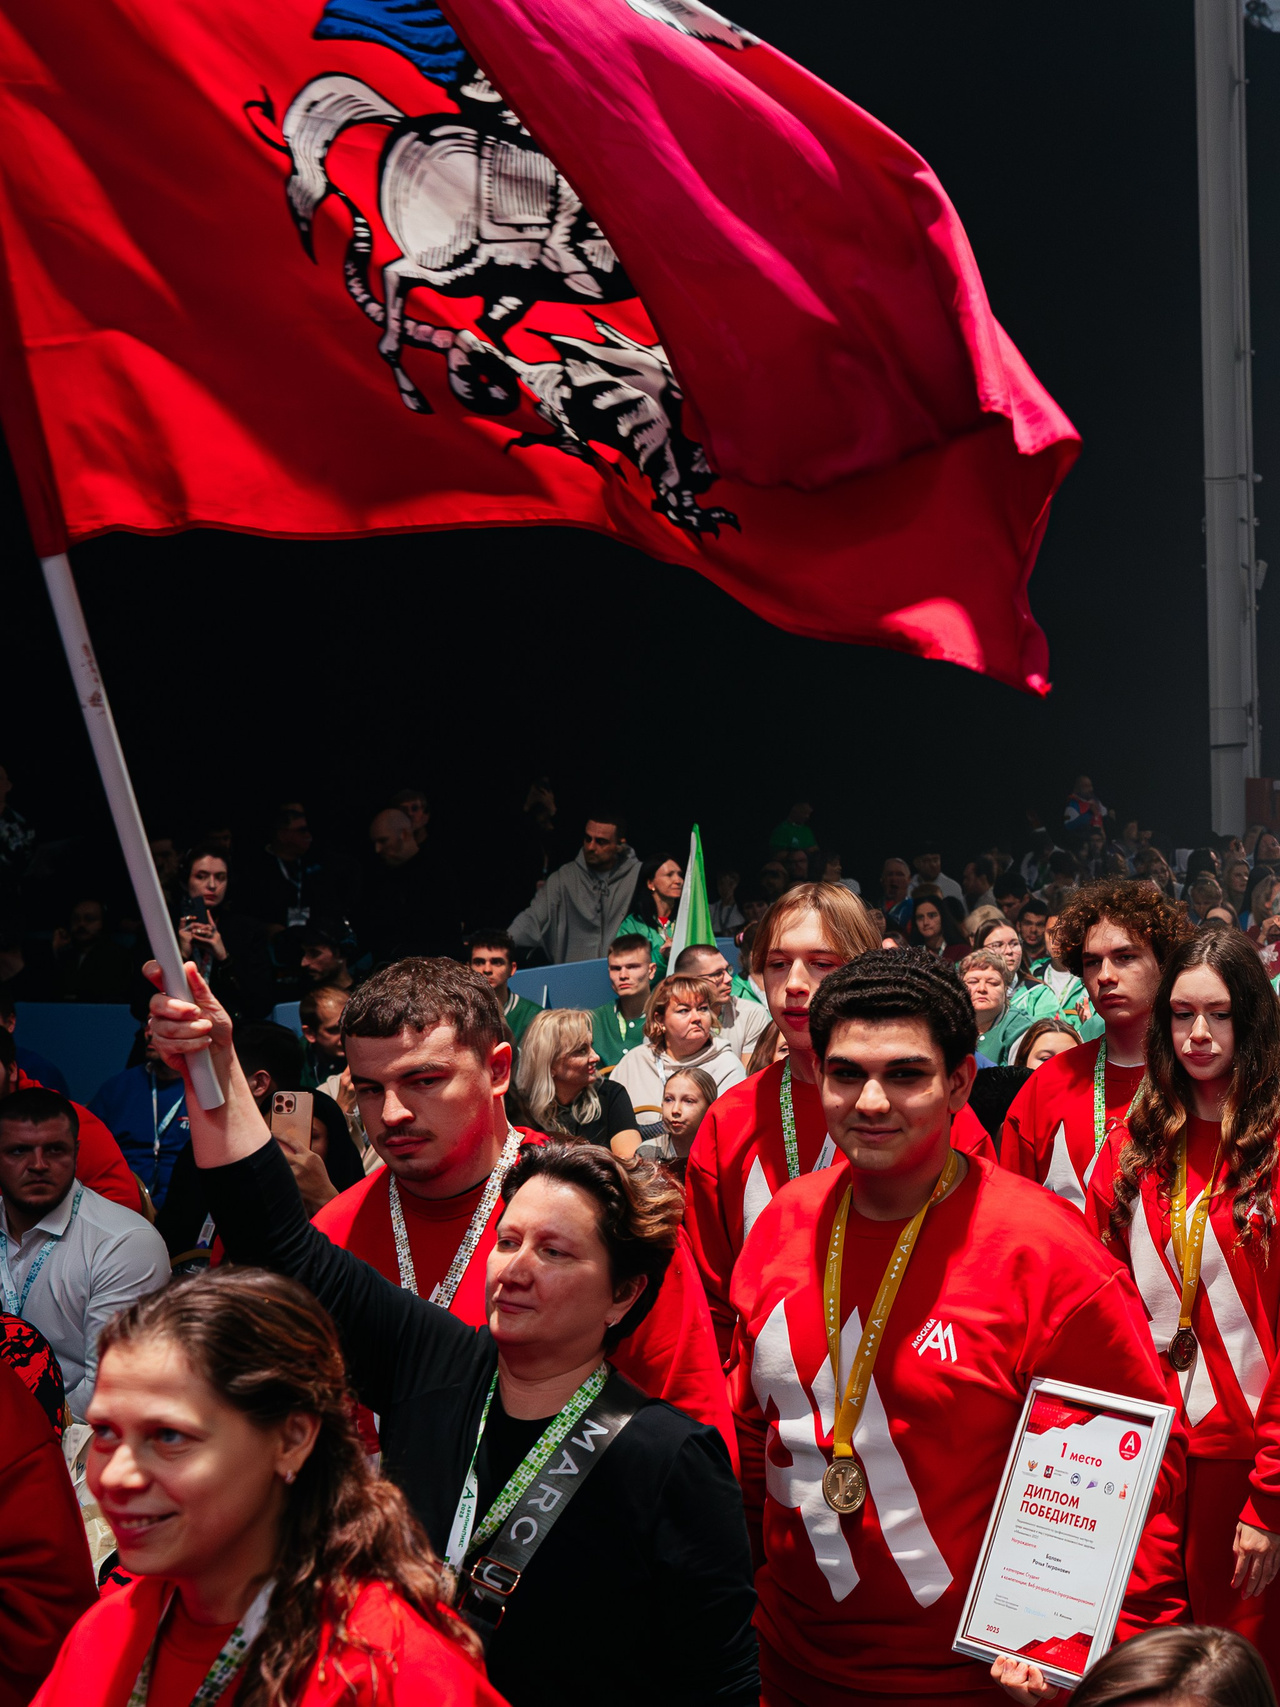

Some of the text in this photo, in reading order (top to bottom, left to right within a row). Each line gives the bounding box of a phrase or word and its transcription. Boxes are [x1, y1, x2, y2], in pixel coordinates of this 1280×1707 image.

[911, 1318, 937, 1349] МОСКВА
[1060, 1442, 1068, 1458] 1
[1069, 1452, 1103, 1468] место
[510, 1418, 610, 1545] MARC
[1023, 1483, 1080, 1509] ДИПЛОМ
[1019, 1500, 1097, 1532] ПОБЕДИТЕЛЯ
[986, 1624, 1000, 1634] 2025
